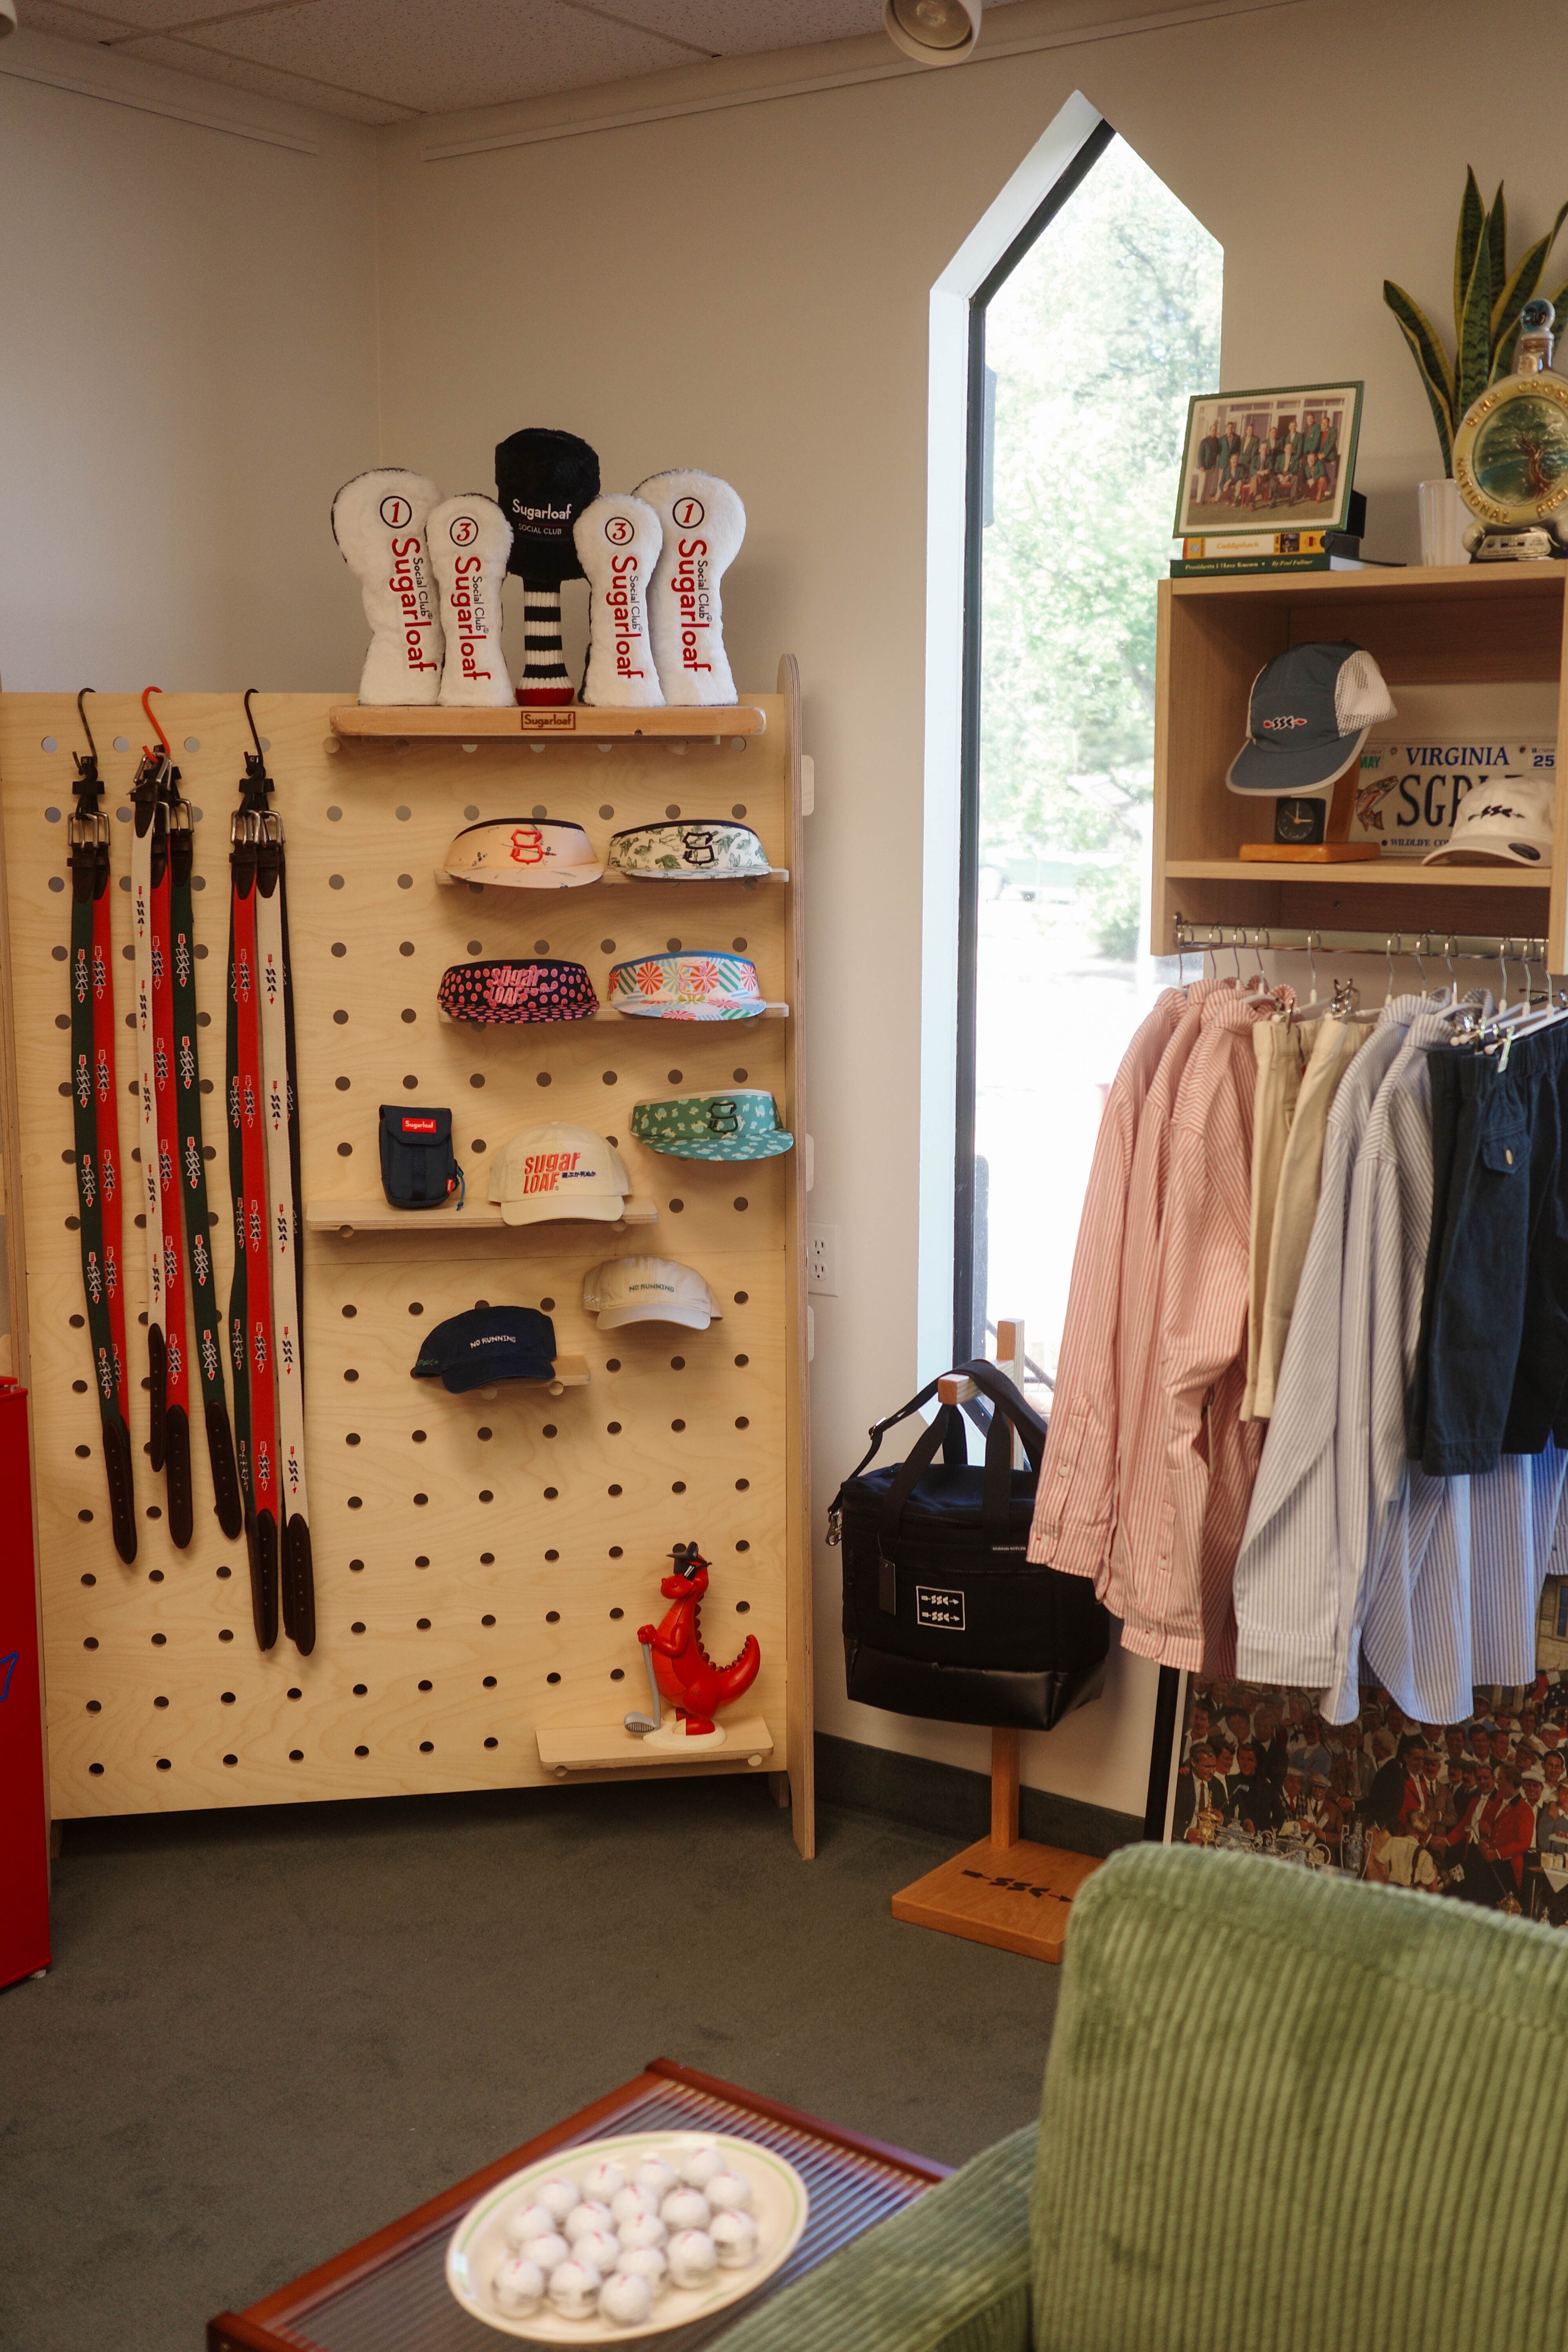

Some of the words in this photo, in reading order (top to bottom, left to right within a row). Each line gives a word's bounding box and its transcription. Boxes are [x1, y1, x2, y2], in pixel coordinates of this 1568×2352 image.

[1456, 458, 1510, 523] NATIONAL
[391, 501, 400, 523] 1
[512, 499, 572, 520] Sugarloaf
[683, 503, 694, 523] 1
[457, 523, 472, 541] 3
[519, 523, 541, 534] SOCIAL
[612, 523, 626, 540] 3
[1217, 541, 1259, 550] Caddyshack
[413, 557, 427, 588] Social
[698, 560, 709, 590] Social
[472, 576, 484, 604] Social
[630, 575, 639, 603] Social
[389, 537, 437, 672] Sugarloaf
[671, 538, 711, 672] Sugarloaf
[451, 556, 491, 680] Sugarloaf
[606, 555, 644, 679] Sugarloaf
[524, 714, 572, 728] Sugarloaf
[1406, 747, 1510, 766] VIRGINIA
[1534, 755, 1554, 767] 25
[489, 986, 522, 1004] LOAF
[405, 1120, 434, 1129] Sugarloaf
[523, 1172, 559, 1194] LOAF
[641, 1284, 674, 1292] RUNNING
[470, 1339, 481, 1349] NO
[482, 1335, 516, 1345] RUNNING
